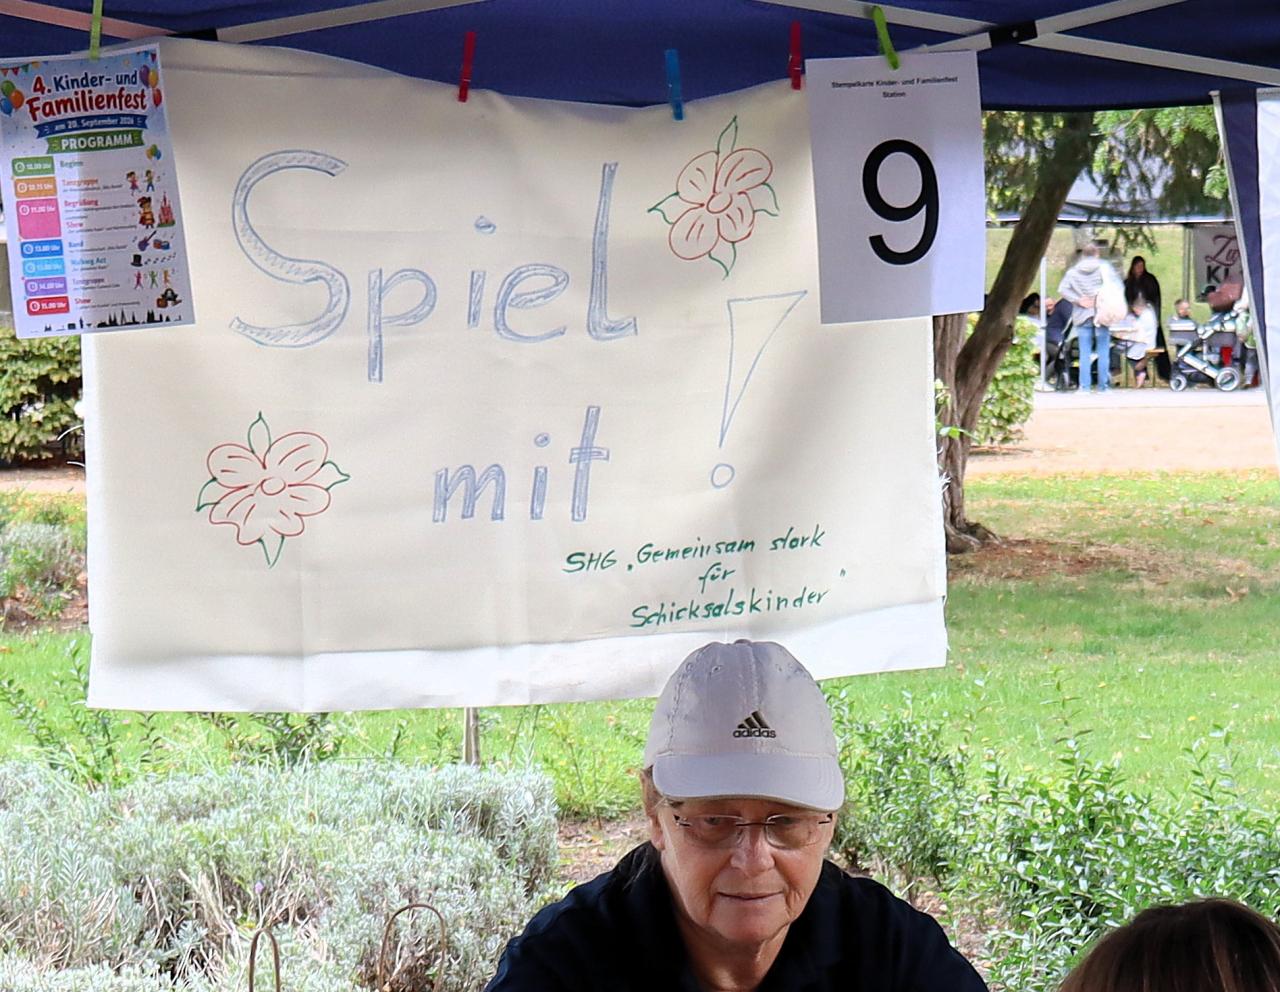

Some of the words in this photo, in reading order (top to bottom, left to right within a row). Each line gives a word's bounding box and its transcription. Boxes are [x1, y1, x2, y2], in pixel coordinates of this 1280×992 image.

[33, 76, 52, 94] 4.
[53, 72, 111, 92] Kinder-
[116, 70, 138, 85] und
[916, 76, 958, 84] Familienfest
[26, 87, 147, 121] Familienfest
[81, 116, 119, 127] September
[60, 133, 133, 150] PROGRAMM
[862, 138, 939, 266] 9
[229, 148, 638, 384] Spiel
[433, 405, 610, 522] mit
[562, 549, 617, 573] SHG
[698, 562, 736, 594] für
[732, 728, 776, 739] adidas
